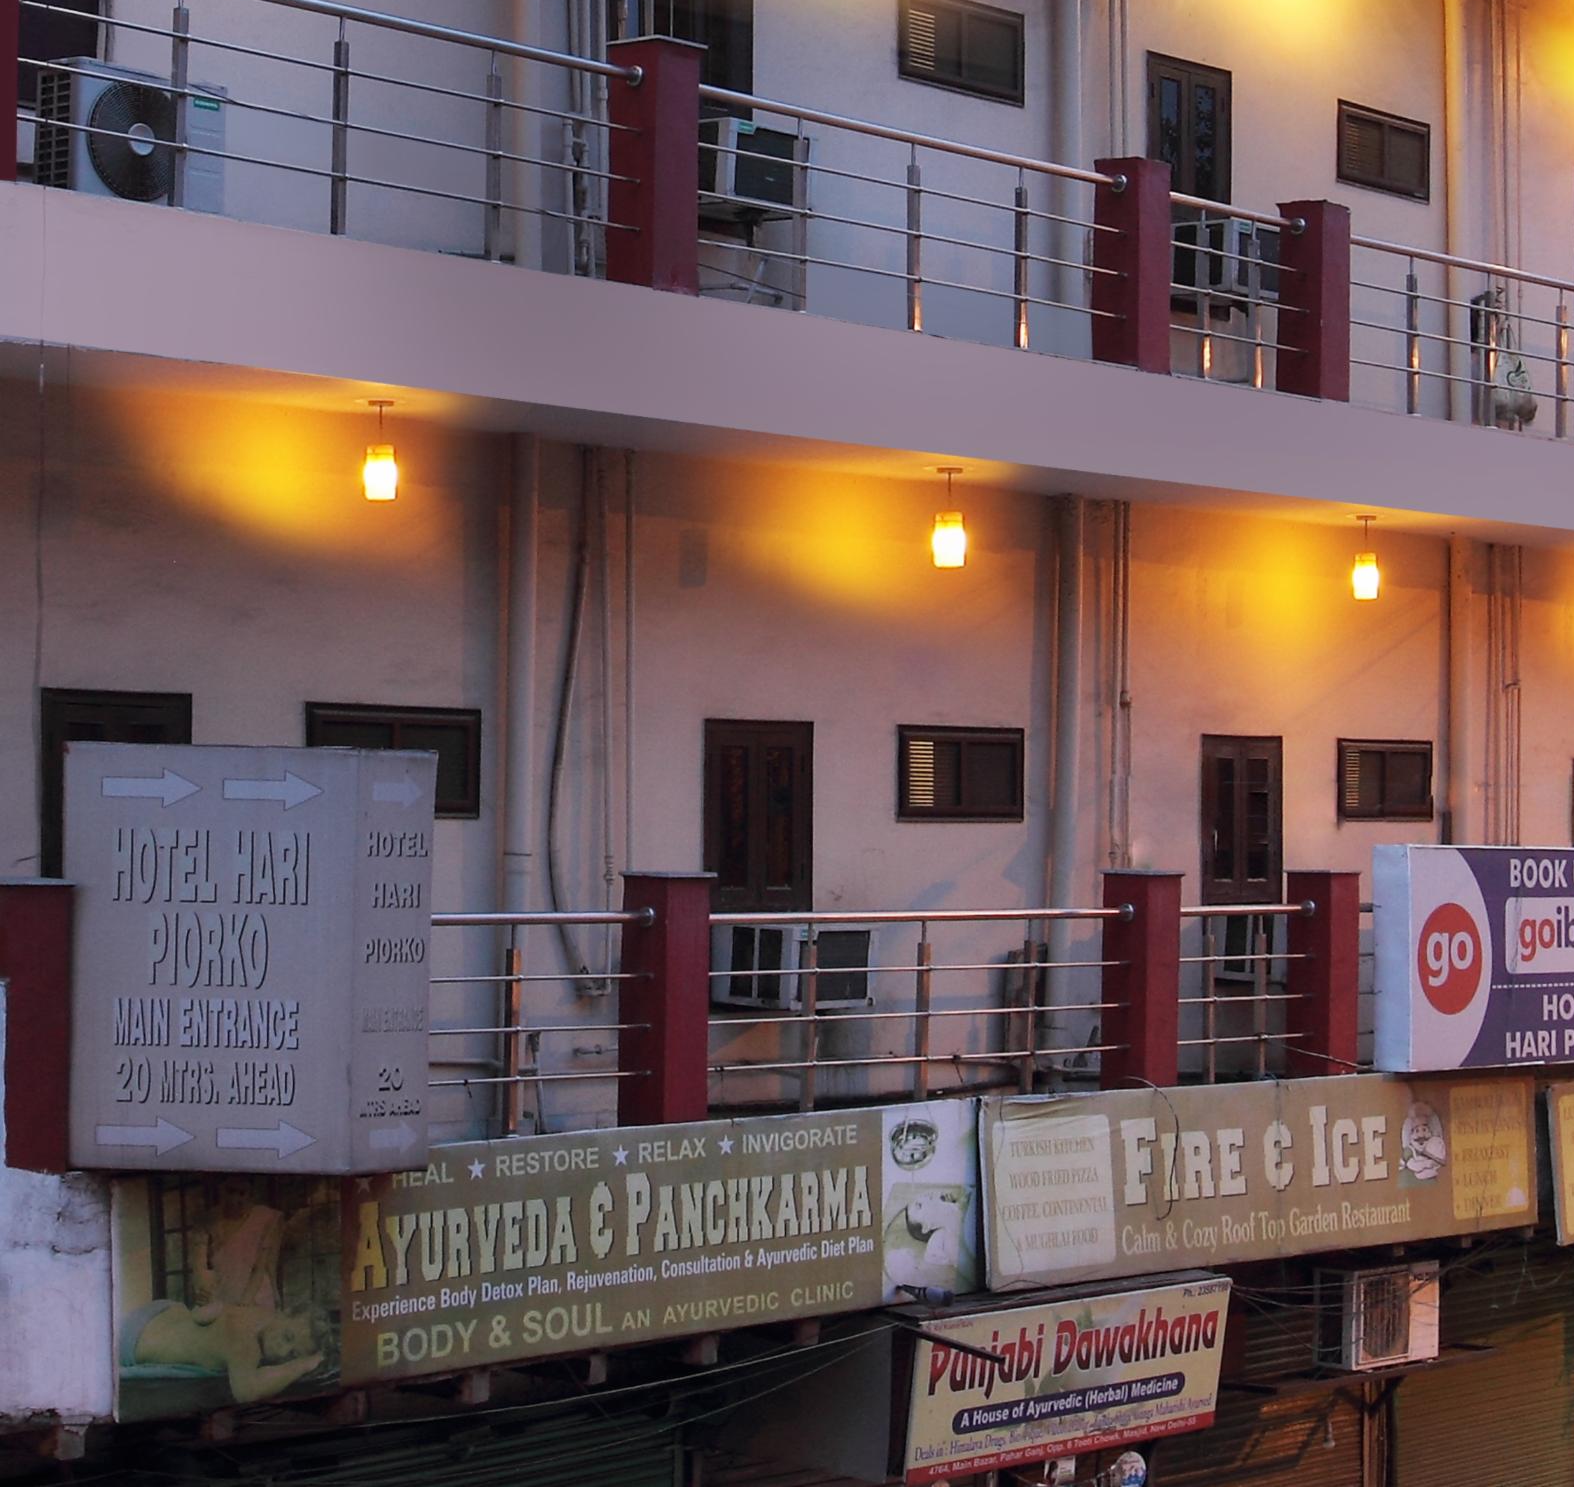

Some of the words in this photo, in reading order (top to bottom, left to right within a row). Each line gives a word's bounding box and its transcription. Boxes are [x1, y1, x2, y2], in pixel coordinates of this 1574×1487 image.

[112, 828, 217, 904] HOTEL
[232, 830, 311, 906] HARI
[366, 832, 429, 858] HOTEL
[371, 883, 421, 909] HARI
[1509, 858, 1568, 889] BOOK
[148, 912, 269, 989] PIORKO
[364, 938, 425, 964] PIORKO
[1426, 930, 1474, 987] go
[113, 997, 171, 1047] MAIN
[179, 998, 300, 1051] ENTRANCE
[1505, 1031, 1557, 1059] HARI
[115, 1056, 152, 1104] 20
[159, 1059, 219, 1106] MTRS.
[228, 1061, 296, 1107] AHEAD
[495, 1146, 599, 1178] RESTORE
[638, 1137, 706, 1165] RELAX
[742, 1124, 858, 1155] INVIGORATE
[1120, 1116, 1247, 1207] FIRE
[1309, 1105, 1390, 1187] ICE
[351, 1199, 578, 1292] AYURVEDA
[625, 1165, 874, 1255] PANCHKARMA
[1122, 1224, 1161, 1256] Calm
[1165, 1225, 1179, 1245] &
[1182, 1220, 1219, 1253] Cozy
[1221, 1213, 1256, 1243] Roof
[1258, 1211, 1285, 1242] Top
[1289, 1204, 1338, 1234] Garden
[1342, 1199, 1412, 1229] Restaurant
[352, 1288, 436, 1323] Experience
[440, 1282, 478, 1309] Body
[482, 1279, 524, 1303] Detox
[661, 1253, 741, 1280] Consultation
[744, 1250, 754, 1268] &
[756, 1242, 817, 1270] Ayurvedic
[820, 1239, 846, 1259] Diet
[847, 1235, 875, 1255] Plan
[377, 1320, 477, 1368] BODY
[488, 1315, 511, 1348] &
[522, 1303, 613, 1346] SOUL
[620, 1309, 651, 1331] AN
[662, 1291, 779, 1325] AYURVEDIC
[790, 1280, 855, 1310] CLINIC
[928, 1323, 1045, 1400] Punjabi
[1053, 1307, 1219, 1376] Dawakhana
[960, 1413, 970, 1428] A
[973, 1407, 1009, 1426] House
[1012, 1402, 1026, 1419] of
[1026, 1392, 1083, 1418] Ayurvedic
[1085, 1387, 1129, 1409] (Herbal)
[1131, 1377, 1179, 1398] Medicine
[952, 1460, 972, 1472] Main
